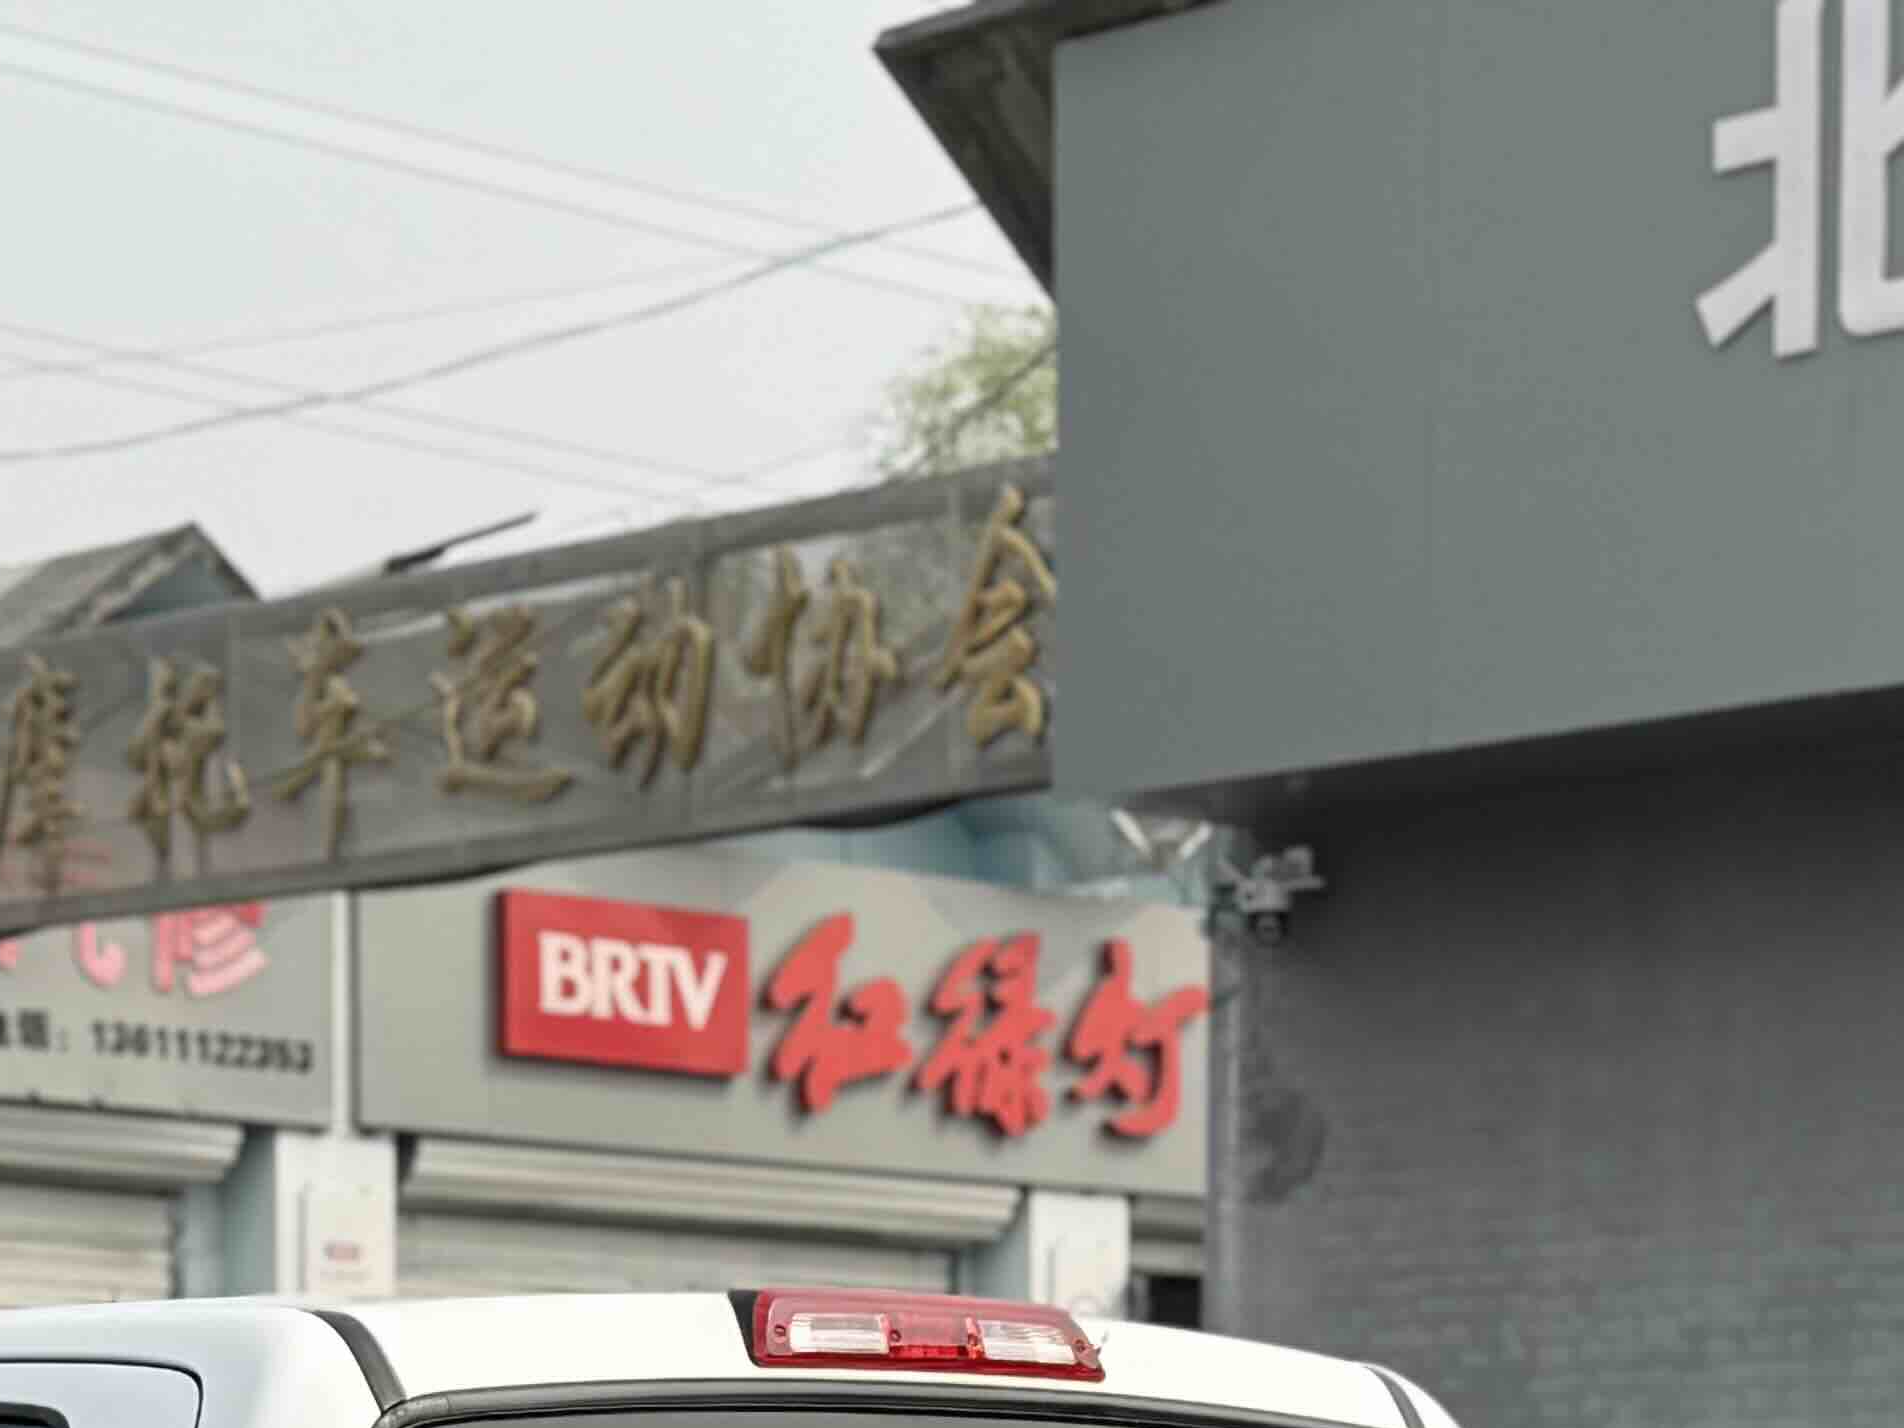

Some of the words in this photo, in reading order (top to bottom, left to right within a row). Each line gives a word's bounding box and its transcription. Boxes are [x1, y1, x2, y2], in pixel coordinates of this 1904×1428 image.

[537, 930, 728, 1033] BRTV
[764, 912, 1210, 1138] 红绿灯
